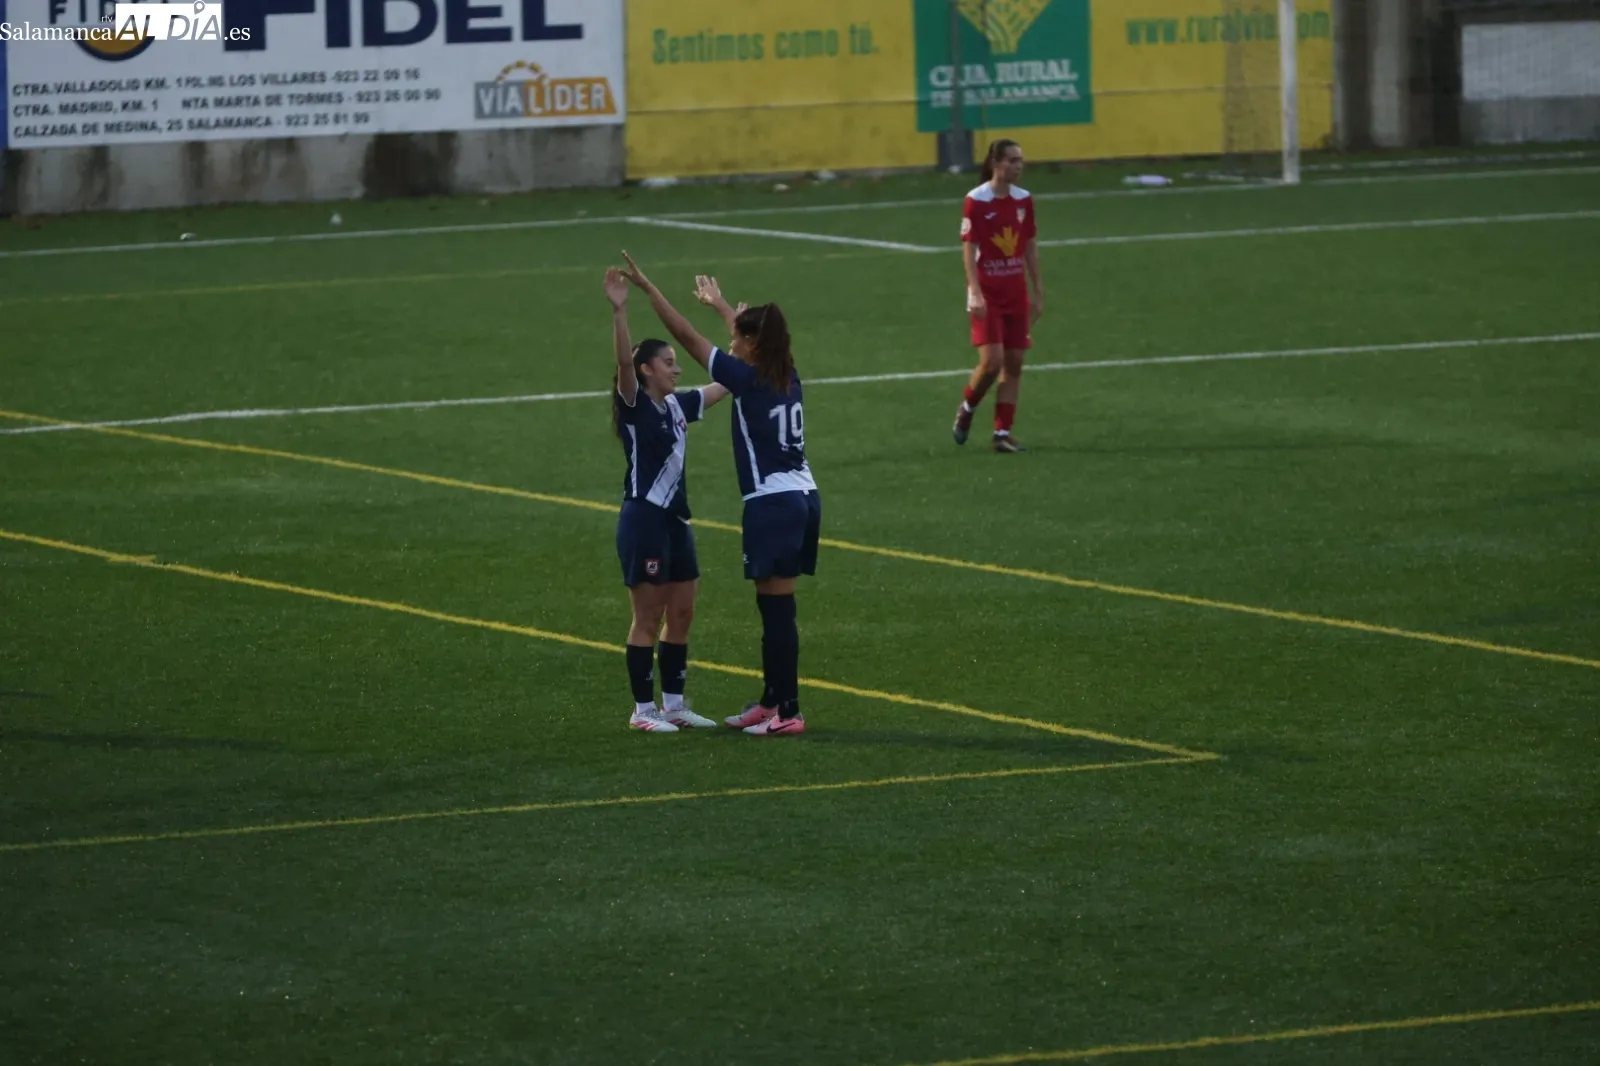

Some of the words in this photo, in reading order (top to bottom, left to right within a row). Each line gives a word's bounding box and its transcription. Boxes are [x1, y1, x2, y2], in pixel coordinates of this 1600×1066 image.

[652, 28, 765, 64] Sentimos
[775, 29, 839, 59] como
[144, 77, 170, 90] KM.
[229, 73, 256, 86] LOS
[260, 71, 326, 86] VILLARES
[994, 59, 1079, 84] RURAL
[13, 103, 55, 118] CTRA.
[58, 100, 117, 115] MADRID,
[121, 99, 147, 112] KM.
[152, 98, 158, 111] 1
[213, 94, 261, 109] MARTA
[264, 93, 282, 107] DE
[286, 91, 344, 106] TORMES
[355, 90, 381, 104] 923
[963, 84, 1080, 106] SALAMANCA
[14, 123, 77, 139] CALZADA
[81, 122, 99, 135] DE
[103, 120, 162, 135] MEDINA,
[187, 115, 272, 130] SALAMANCA
[284, 113, 309, 128] 923
[769, 403, 805, 452] 19
